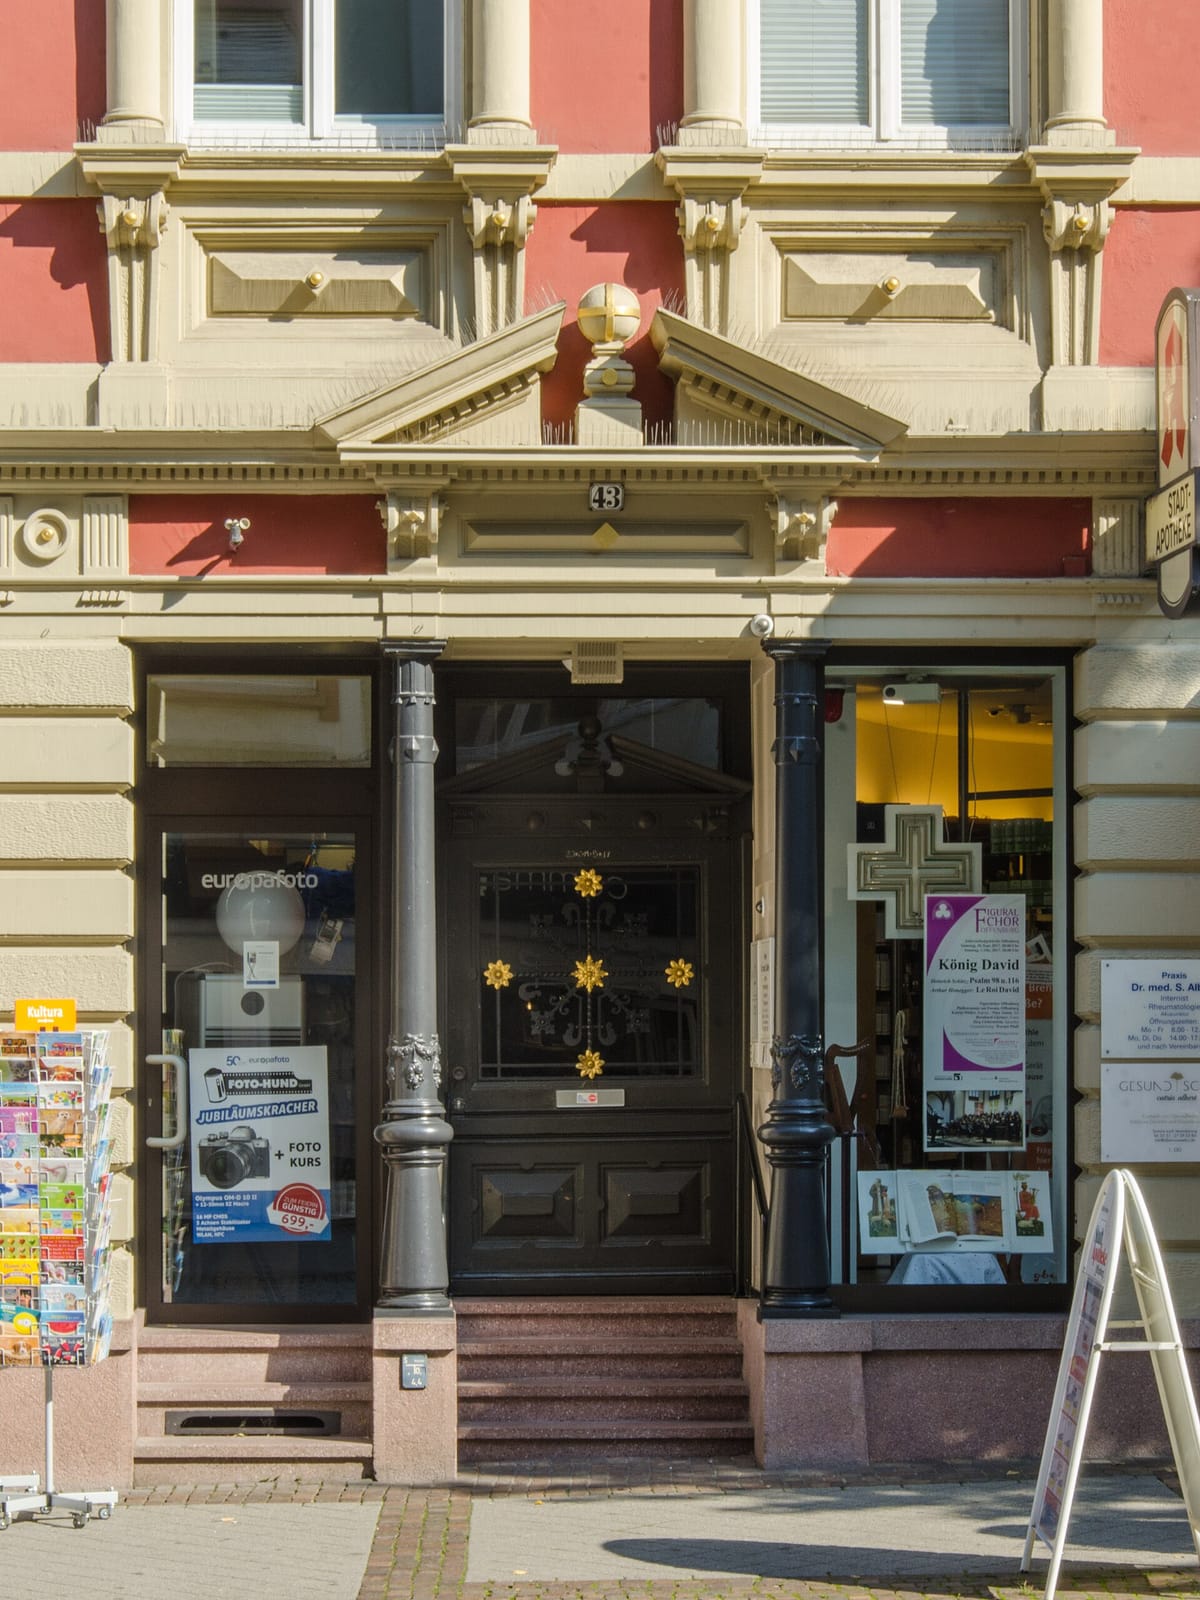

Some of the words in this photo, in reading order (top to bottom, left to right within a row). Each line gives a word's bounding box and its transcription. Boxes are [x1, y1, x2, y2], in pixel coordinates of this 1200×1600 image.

[592, 486, 620, 509] 43
[1168, 483, 1191, 519] STADT-
[1156, 513, 1192, 555] APOTHEKE
[201, 869, 318, 893] europafoto
[987, 916, 1019, 927] CHOR
[938, 958, 978, 972] König
[982, 958, 1020, 970] David
[1161, 971, 1187, 979] Praxis
[1131, 983, 1145, 992] Dr.
[1148, 983, 1173, 992] med.
[1175, 983, 1185, 992] S.
[27, 1005, 64, 1018] Kultura
[249, 1056, 290, 1065] europafoto
[228, 1078, 298, 1089] FOTO-HUND
[198, 1102, 317, 1123] JUBILÄUMSKRACHER
[289, 1142, 321, 1153] FOTO
[290, 1157, 321, 1167] KURS
[282, 1202, 317, 1216] GÜNSTIG
[281, 1214, 314, 1230] 699,-
